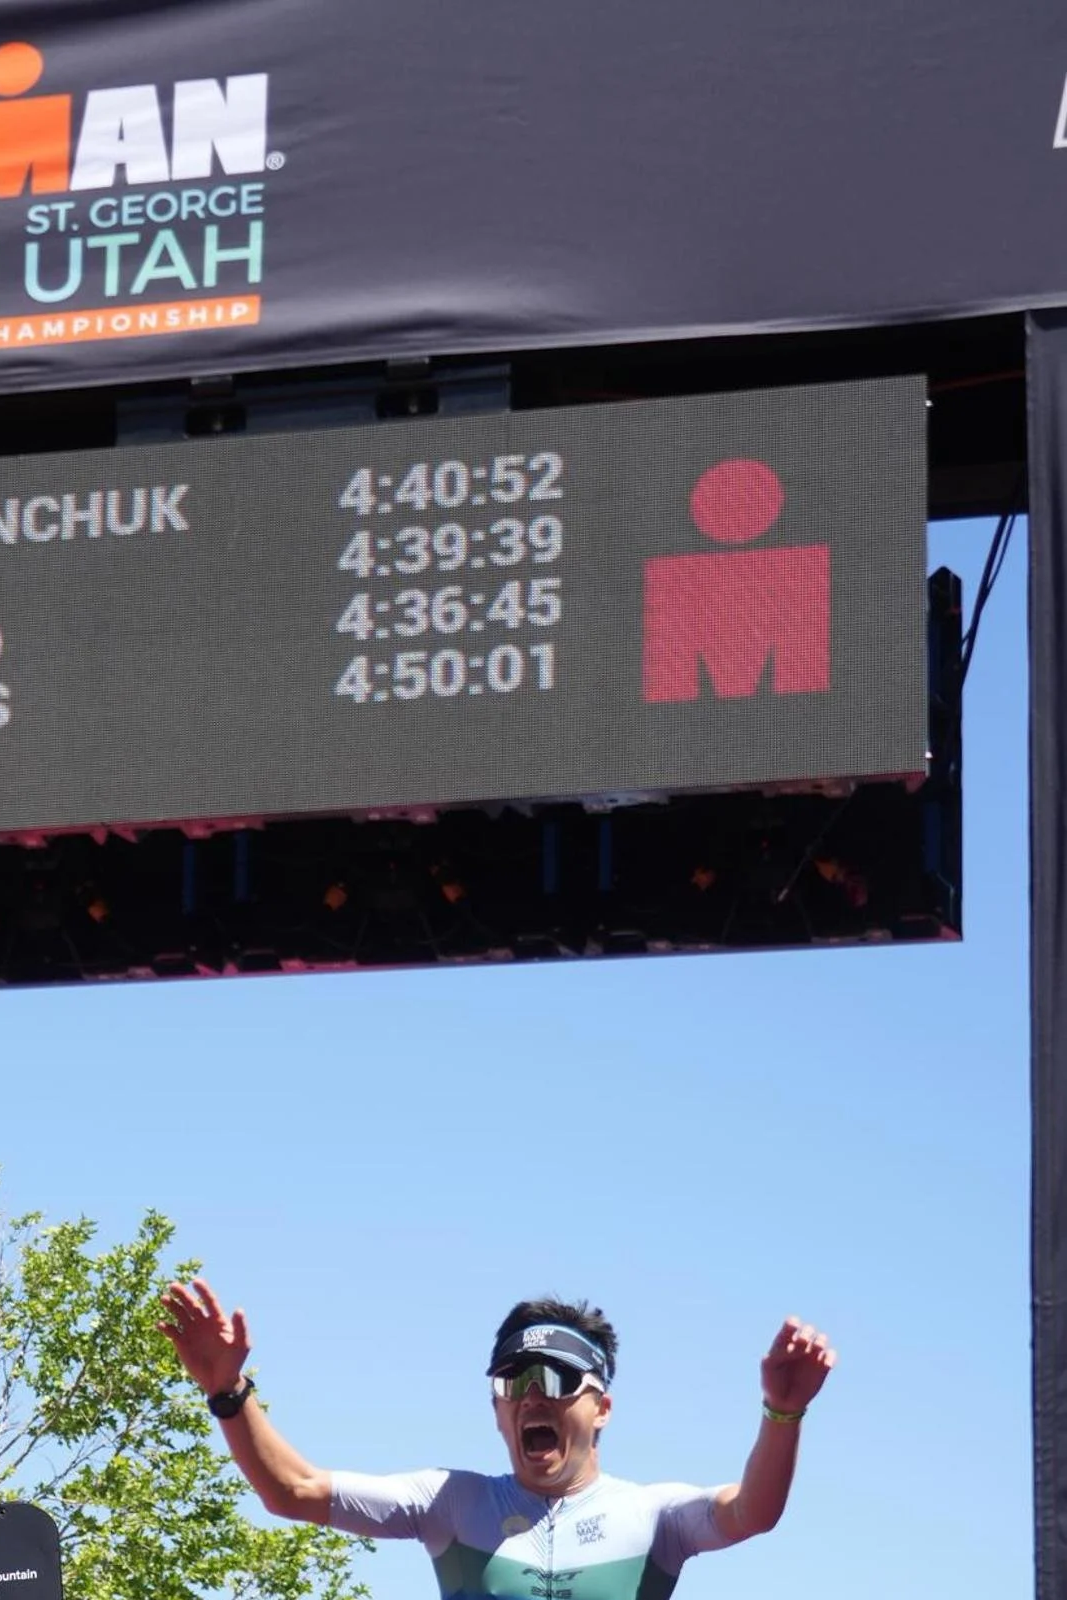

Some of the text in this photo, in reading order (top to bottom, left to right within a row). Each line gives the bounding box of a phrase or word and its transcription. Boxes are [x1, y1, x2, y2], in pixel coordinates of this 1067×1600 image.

[25, 183, 265, 235] ST. GEORGE
[24, 221, 263, 303] UTAH
[339, 452, 565, 515] 4:40:52
[337, 516, 564, 578] 4:39:39
[336, 578, 564, 640] 4:36:45
[334, 643, 557, 704] 4:50:01
